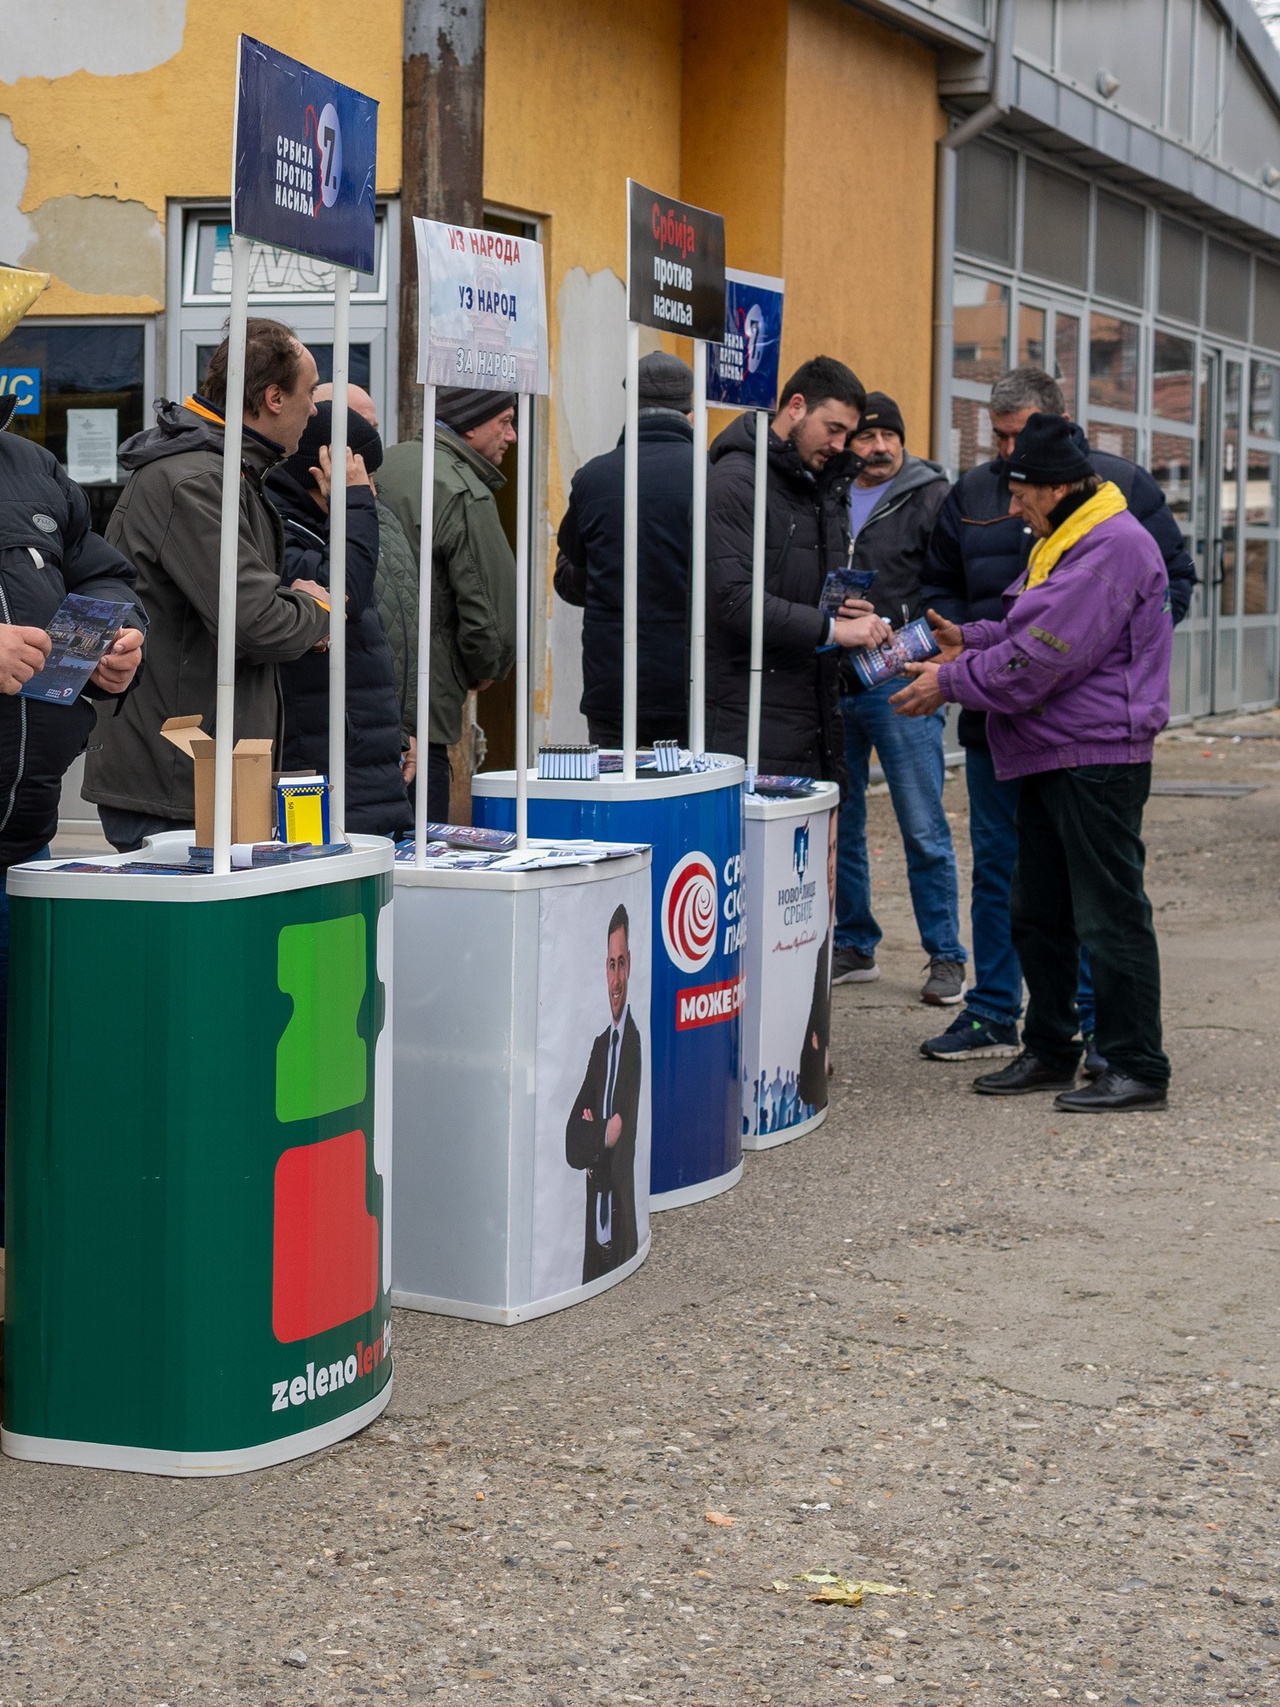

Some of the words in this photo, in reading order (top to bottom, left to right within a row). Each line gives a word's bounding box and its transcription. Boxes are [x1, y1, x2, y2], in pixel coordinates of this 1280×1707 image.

[276, 135, 314, 169] СРБИЈА
[323, 126, 337, 190] 7.
[275, 159, 313, 192] ПРОТИВ
[275, 184, 315, 217] НАСИЉА
[447, 228, 466, 253] ИЗ
[469, 232, 521, 266] НАРОДА
[652, 203, 695, 259] Србија
[653, 256, 693, 292] против
[458, 285, 474, 310] УЗ
[477, 289, 517, 321] НАРОД
[653, 294, 693, 327] насиља
[724, 332, 744, 351] РБИЈА
[456, 347, 473, 374] ЗА
[477, 350, 517, 383] НАРОД
[288, 801, 294, 810] 50
[778, 886, 800, 906] НОВО
[680, 988, 732, 1023] МОЖЕ
